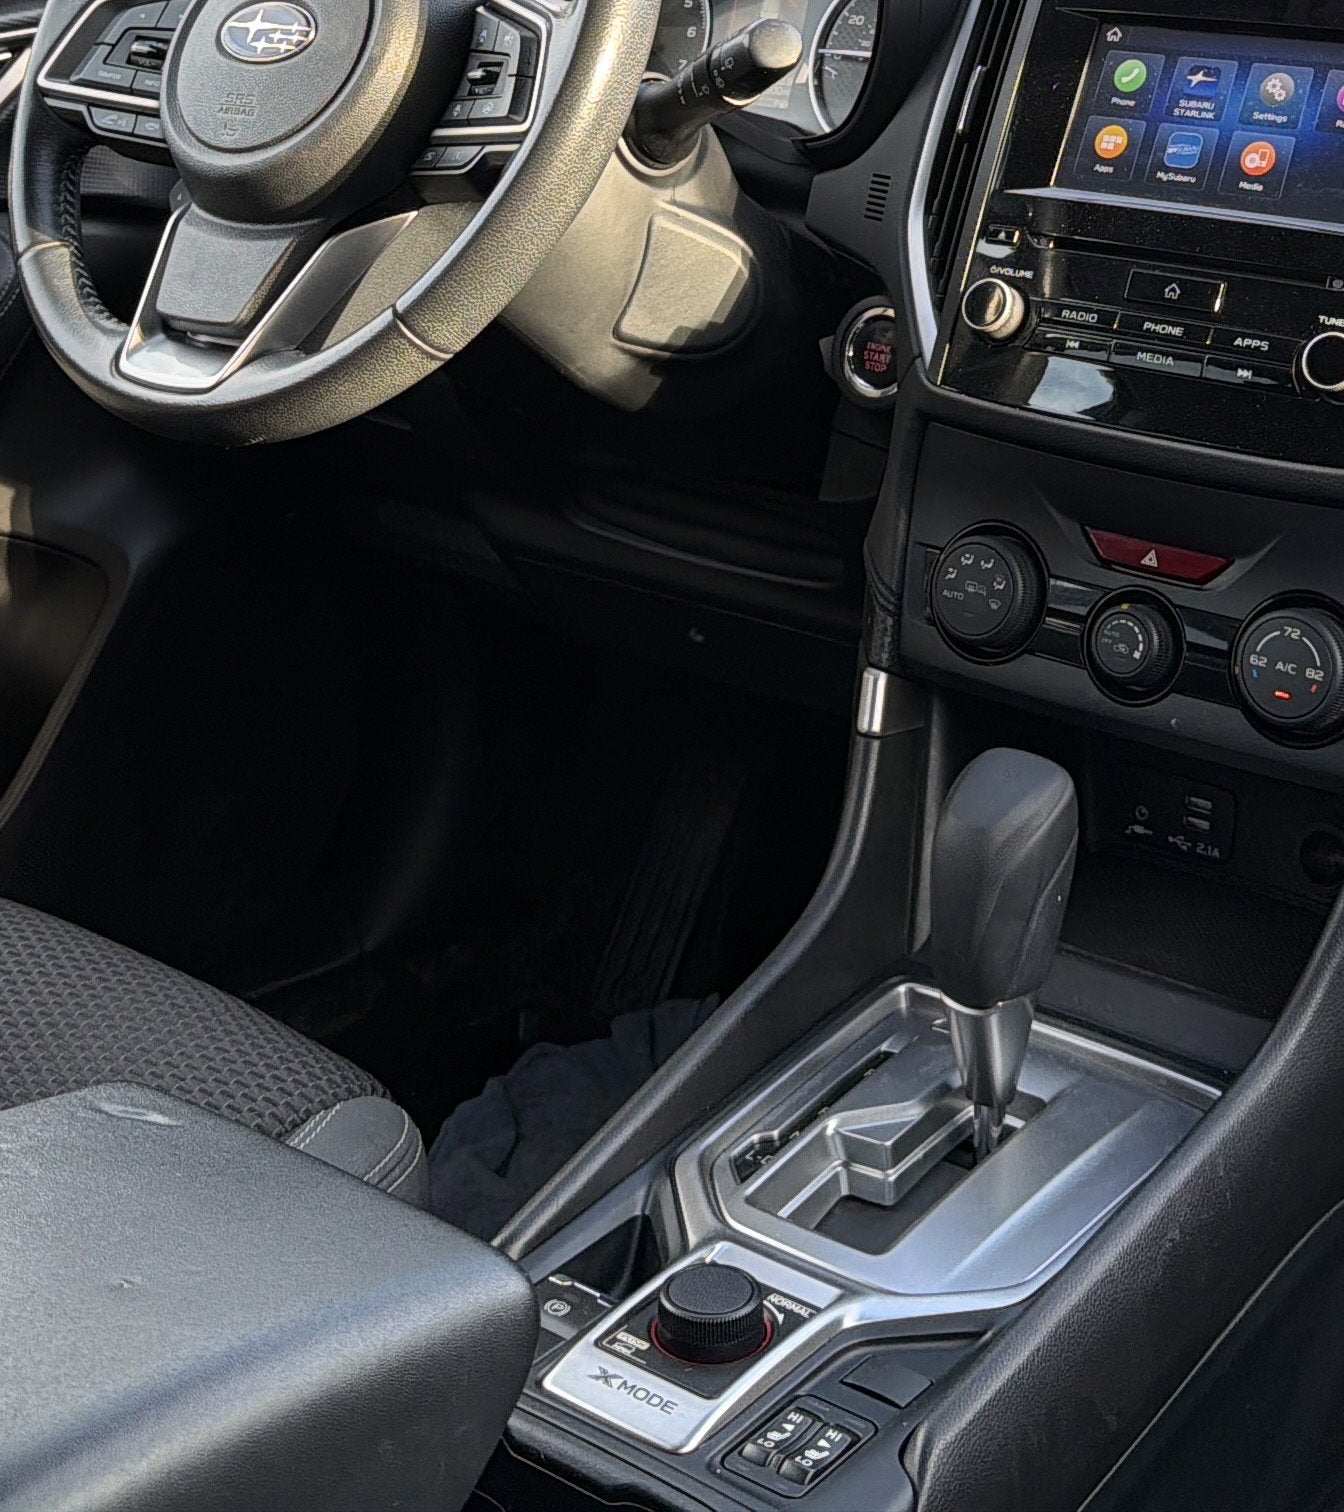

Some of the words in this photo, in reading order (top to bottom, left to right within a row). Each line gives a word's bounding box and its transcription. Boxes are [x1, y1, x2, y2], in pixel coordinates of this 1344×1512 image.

[847, 14, 865, 26] 20
[686, 26, 697, 38] 6
[223, 92, 255, 105] SRS
[1110, 96, 1137, 107] Phone
[1178, 99, 1215, 110] SUBARU
[217, 106, 256, 118] AIRBAG
[1172, 108, 1215, 120] STARLINK
[1252, 111, 1288, 123] Settings
[1093, 163, 1114, 174] Apps
[1156, 171, 1197, 184] MySubaru
[1238, 181, 1264, 191] Media
[1061, 309, 1098, 323] RADIO
[1142, 321, 1185, 338] PHONE
[866, 341, 892, 353] ENGINE
[1233, 337, 1270, 352] APPS
[863, 350, 892, 364] START
[1136, 350, 1175, 367] MEDIA
[864, 361, 888, 373] STOP
[942, 589, 965, 601] AUTO
[1283, 626, 1301, 640] 72
[1249, 654, 1268, 667] 62
[1275, 661, 1297, 675] A/C
[1305, 667, 1324, 681] 82
[1196, 842, 1220, 859] 2.1A
[767, 1293, 817, 1319] NORMAL
[786, 1412, 804, 1424] HI
[825, 1429, 843, 1442] HI
[756, 1437, 775, 1448] LO
[794, 1455, 813, 1467] LO
